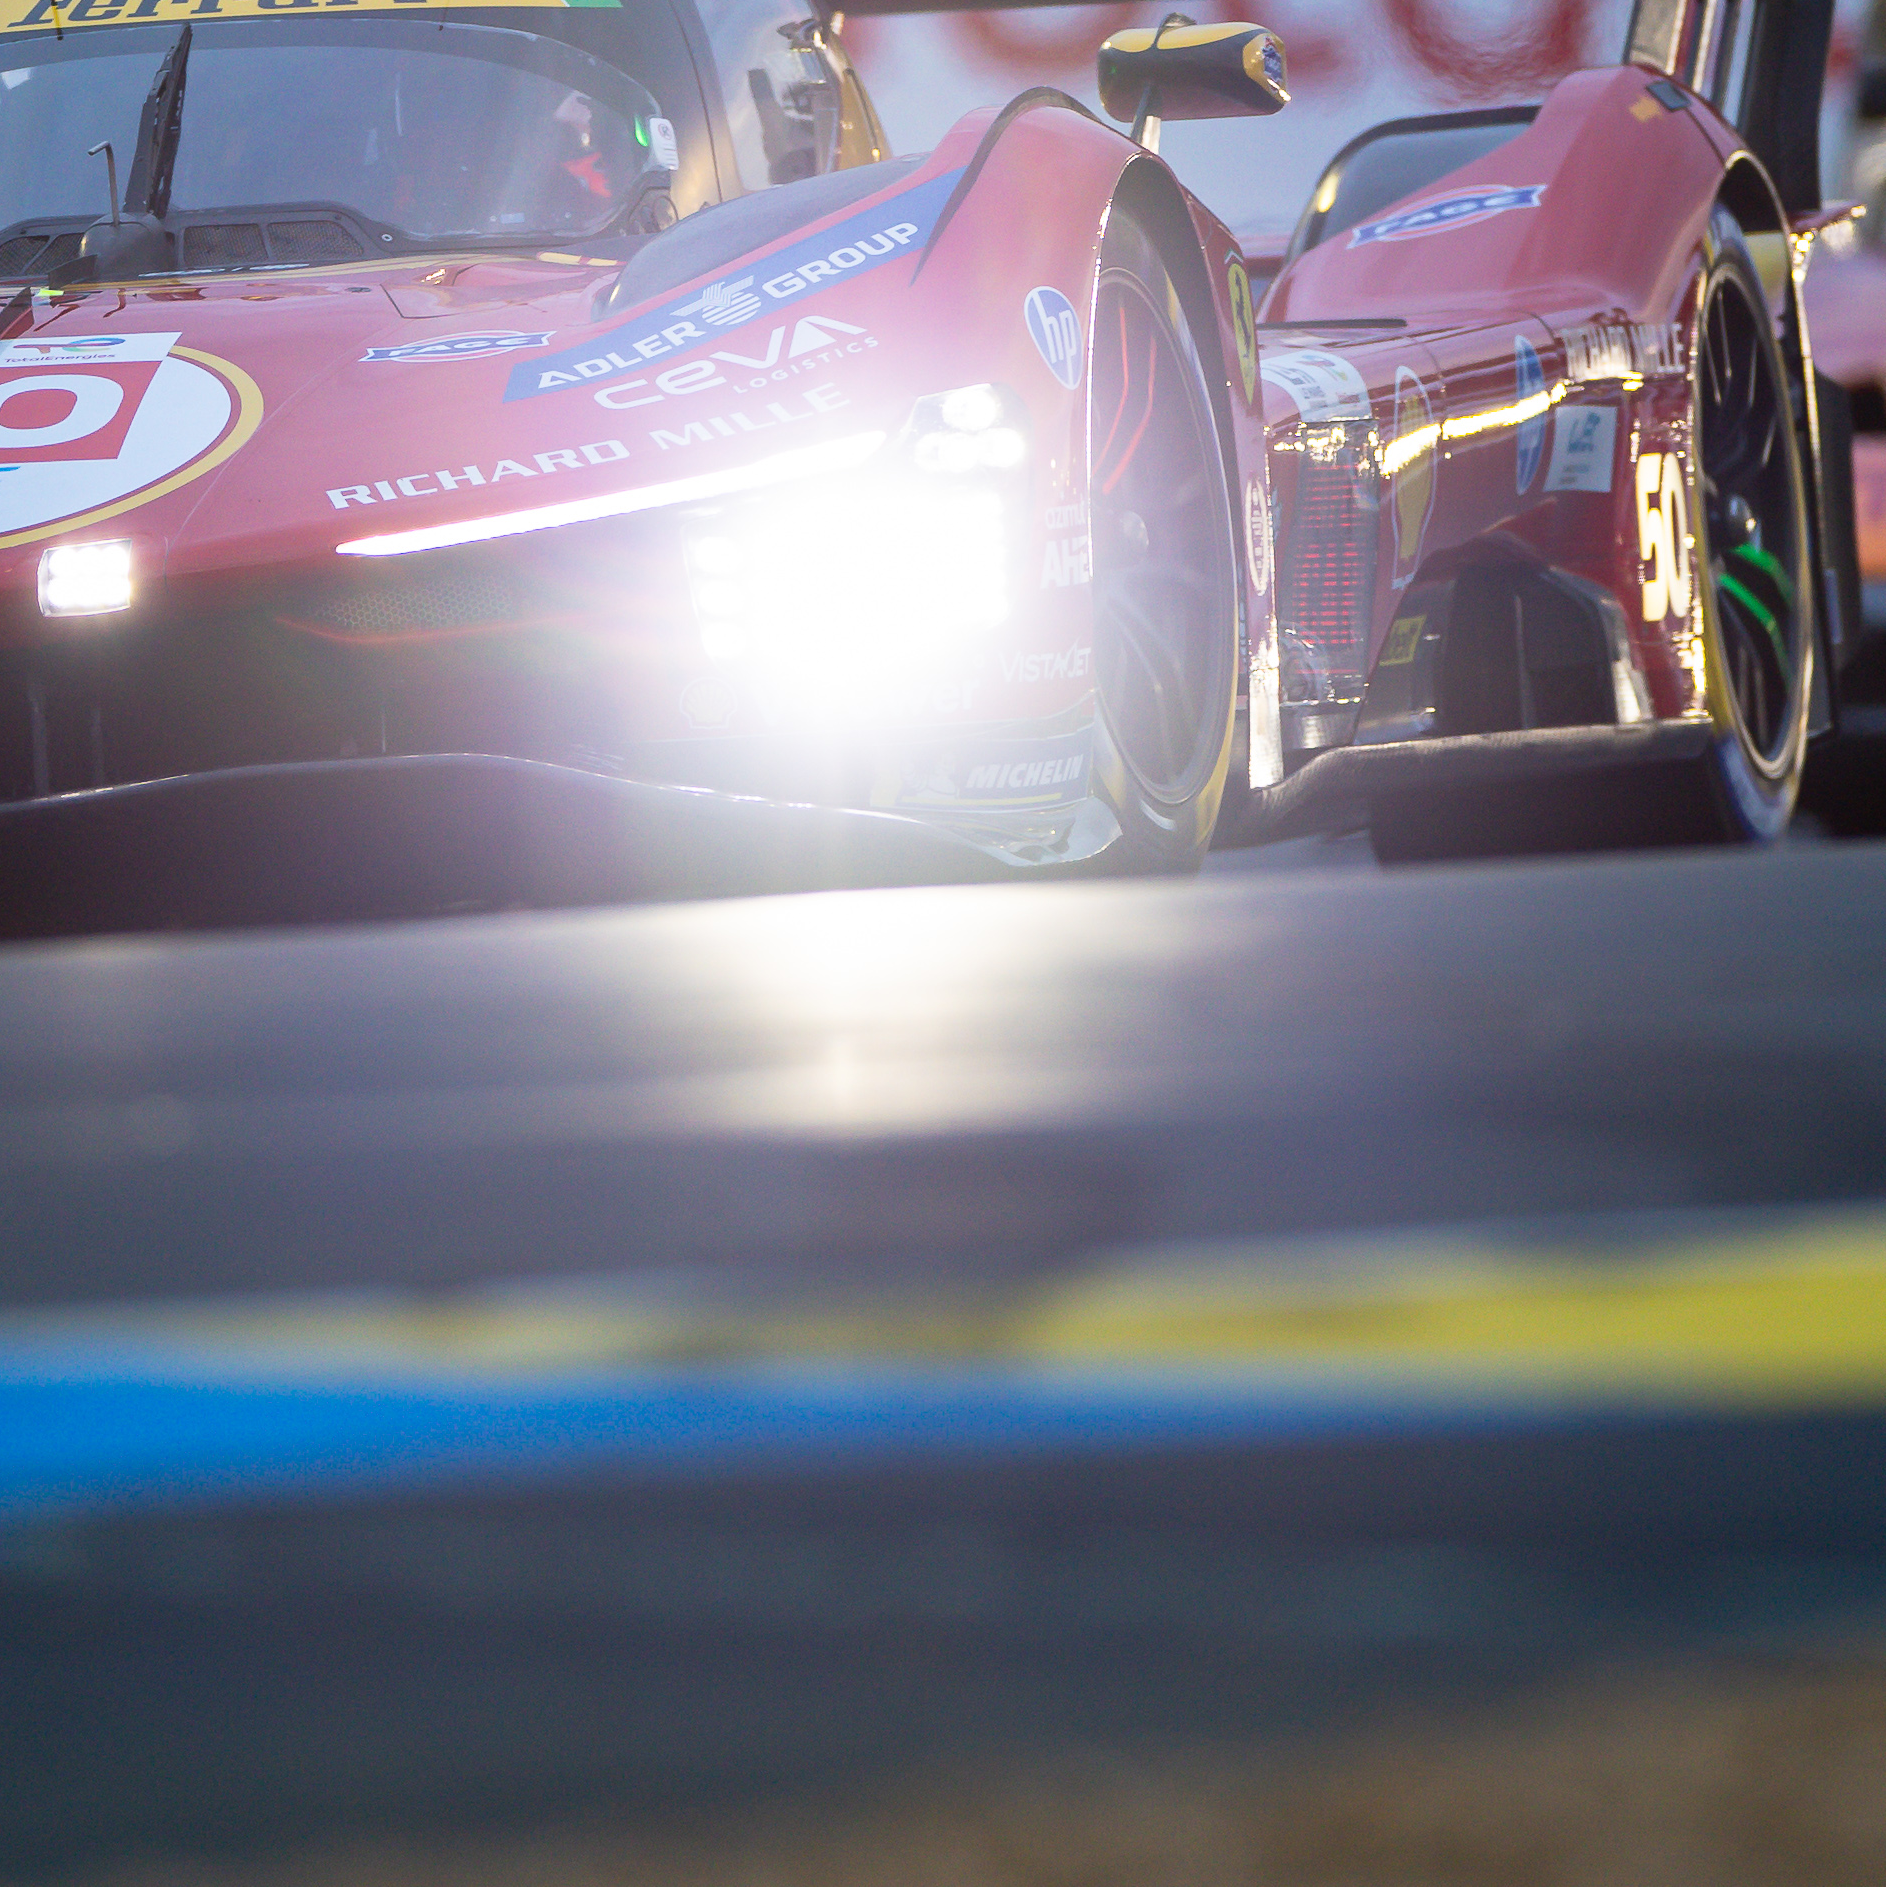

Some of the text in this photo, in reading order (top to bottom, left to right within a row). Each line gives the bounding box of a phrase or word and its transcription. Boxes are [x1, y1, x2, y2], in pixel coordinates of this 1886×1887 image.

[536, 221, 919, 389] ADLER GROUP
[1032, 290, 1077, 386] hp
[4, 353, 116, 363] TotalEnergies
[733, 336, 880, 395] LOGISTICS
[325, 382, 851, 510] RICHARD MILLE
[1636, 452, 1691, 622] 50
[966, 753, 1085, 790] MICHELIN
